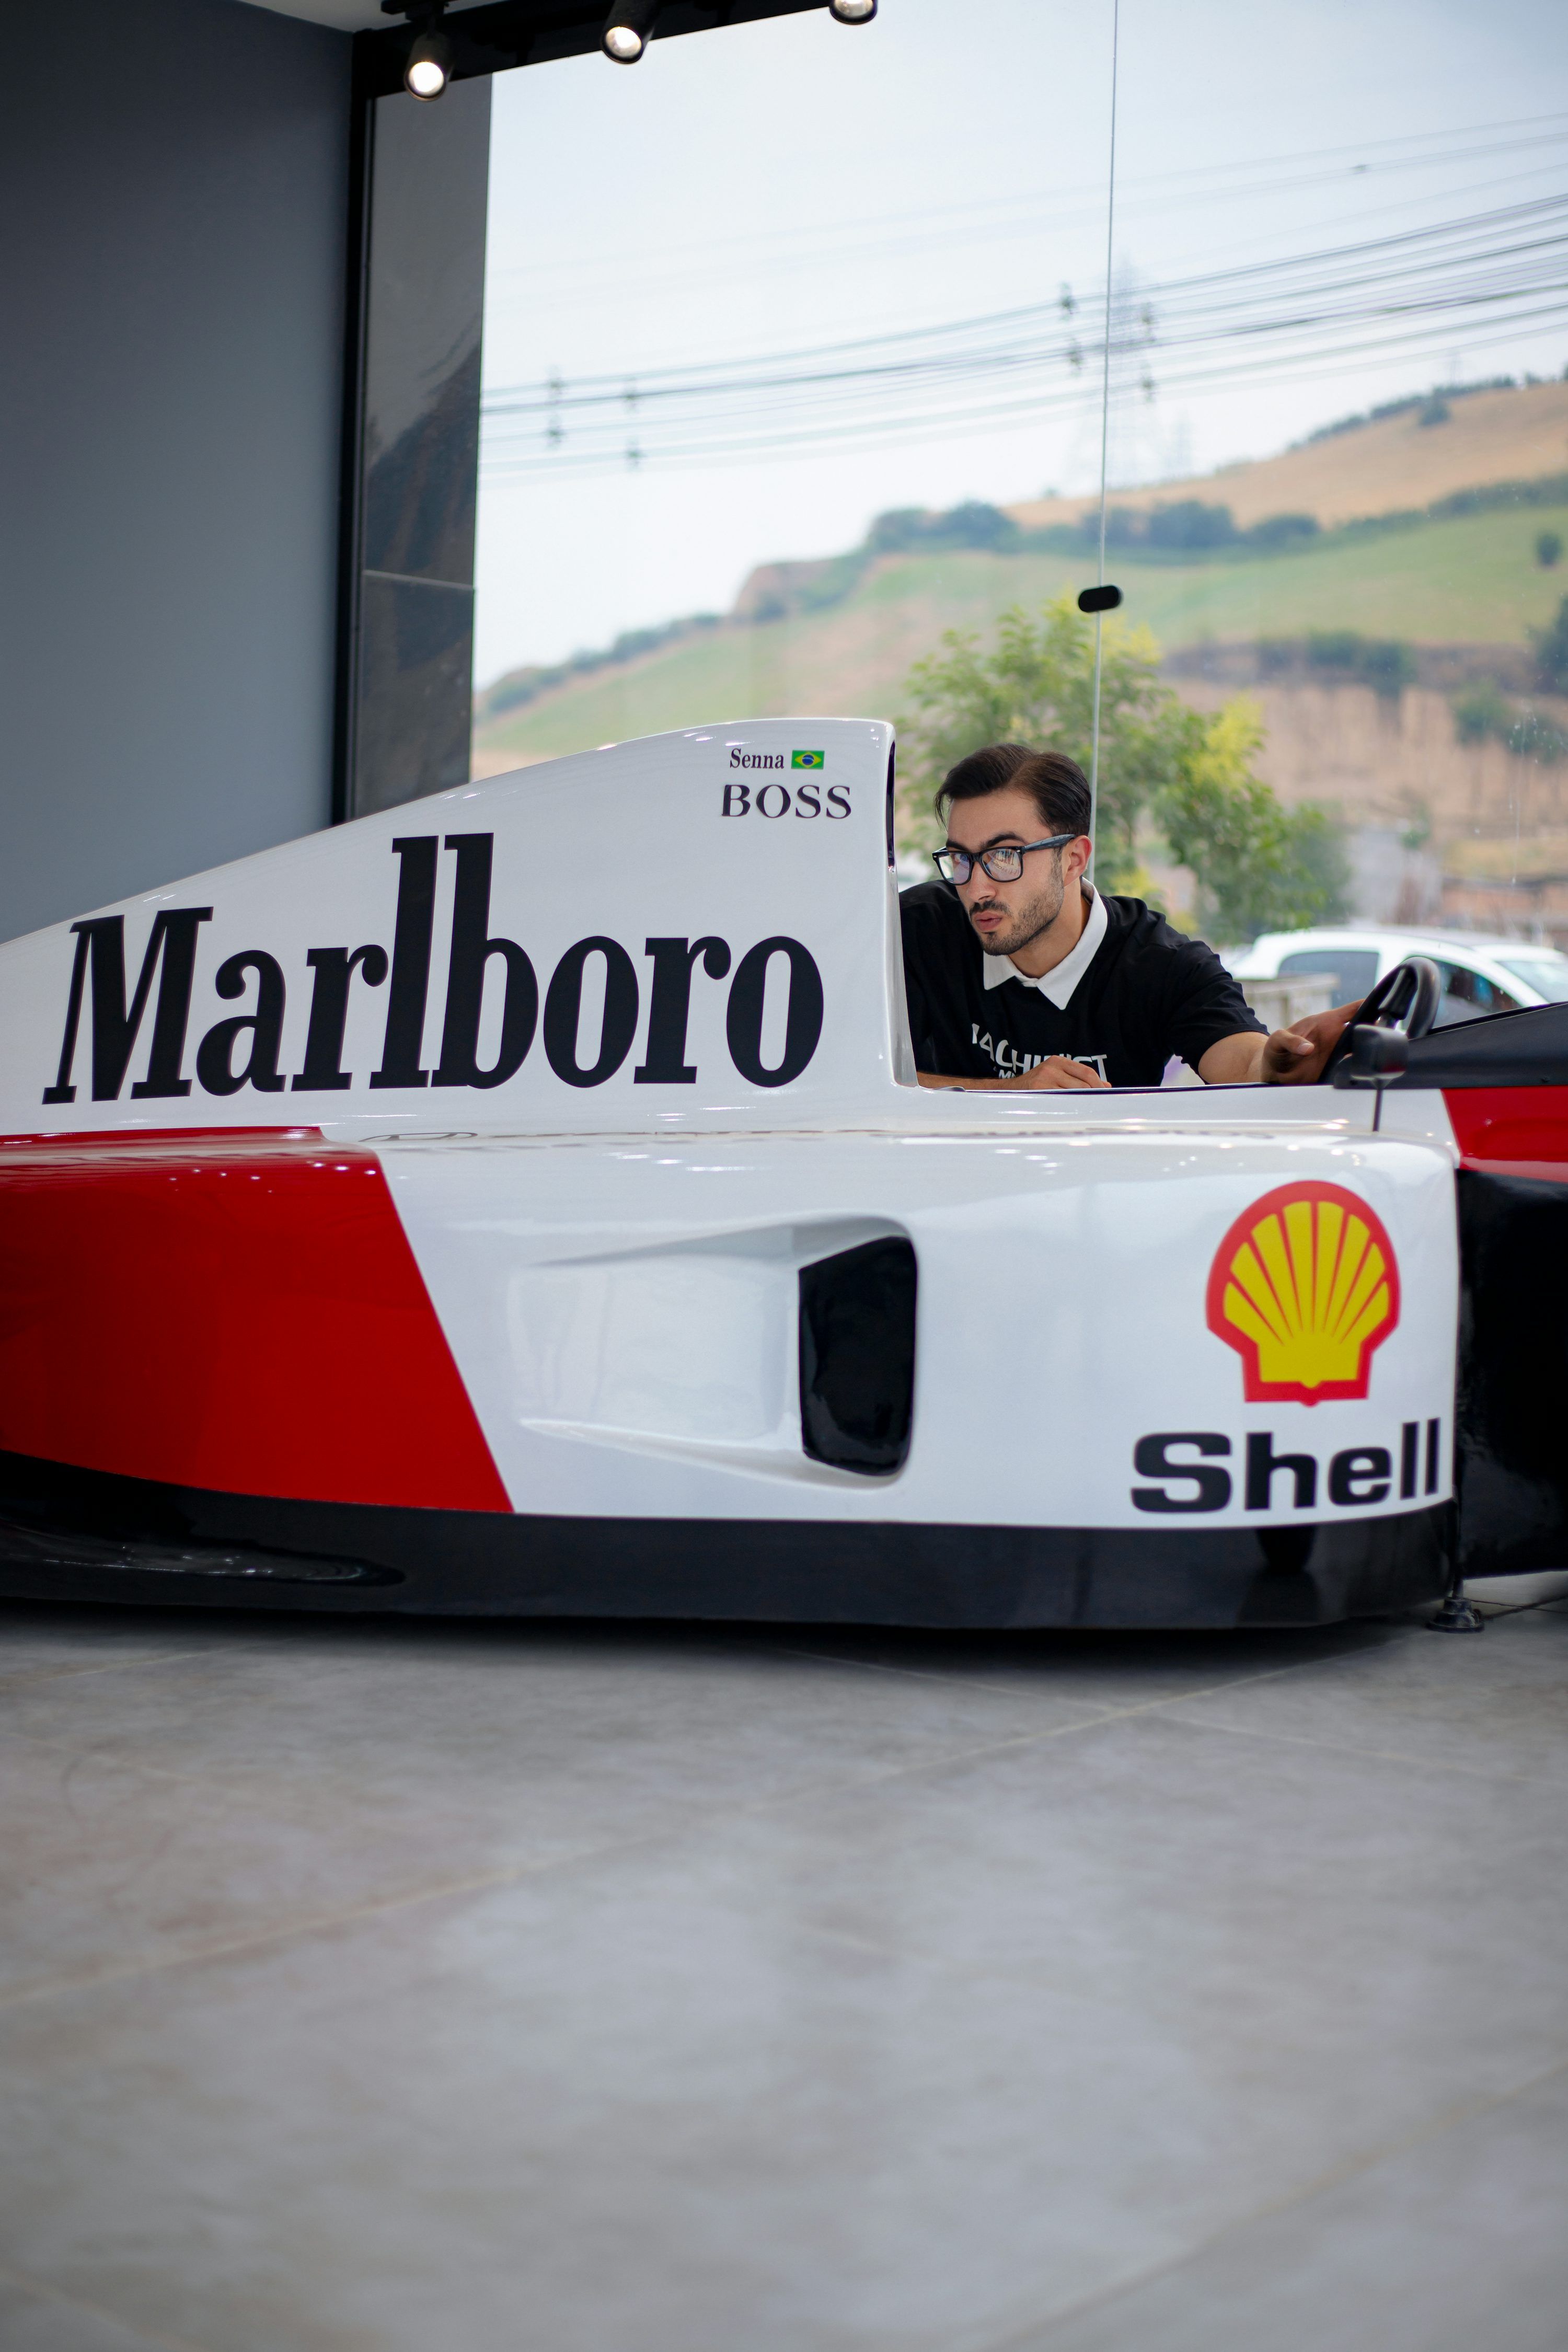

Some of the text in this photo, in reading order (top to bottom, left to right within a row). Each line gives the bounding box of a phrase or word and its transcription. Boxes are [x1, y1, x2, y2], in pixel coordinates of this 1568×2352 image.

[730, 748, 785, 769] Senna
[721, 785, 852, 818] BOSS
[42, 832, 825, 1105] Marlboro
[1131, 1417, 1440, 1512] Shell
